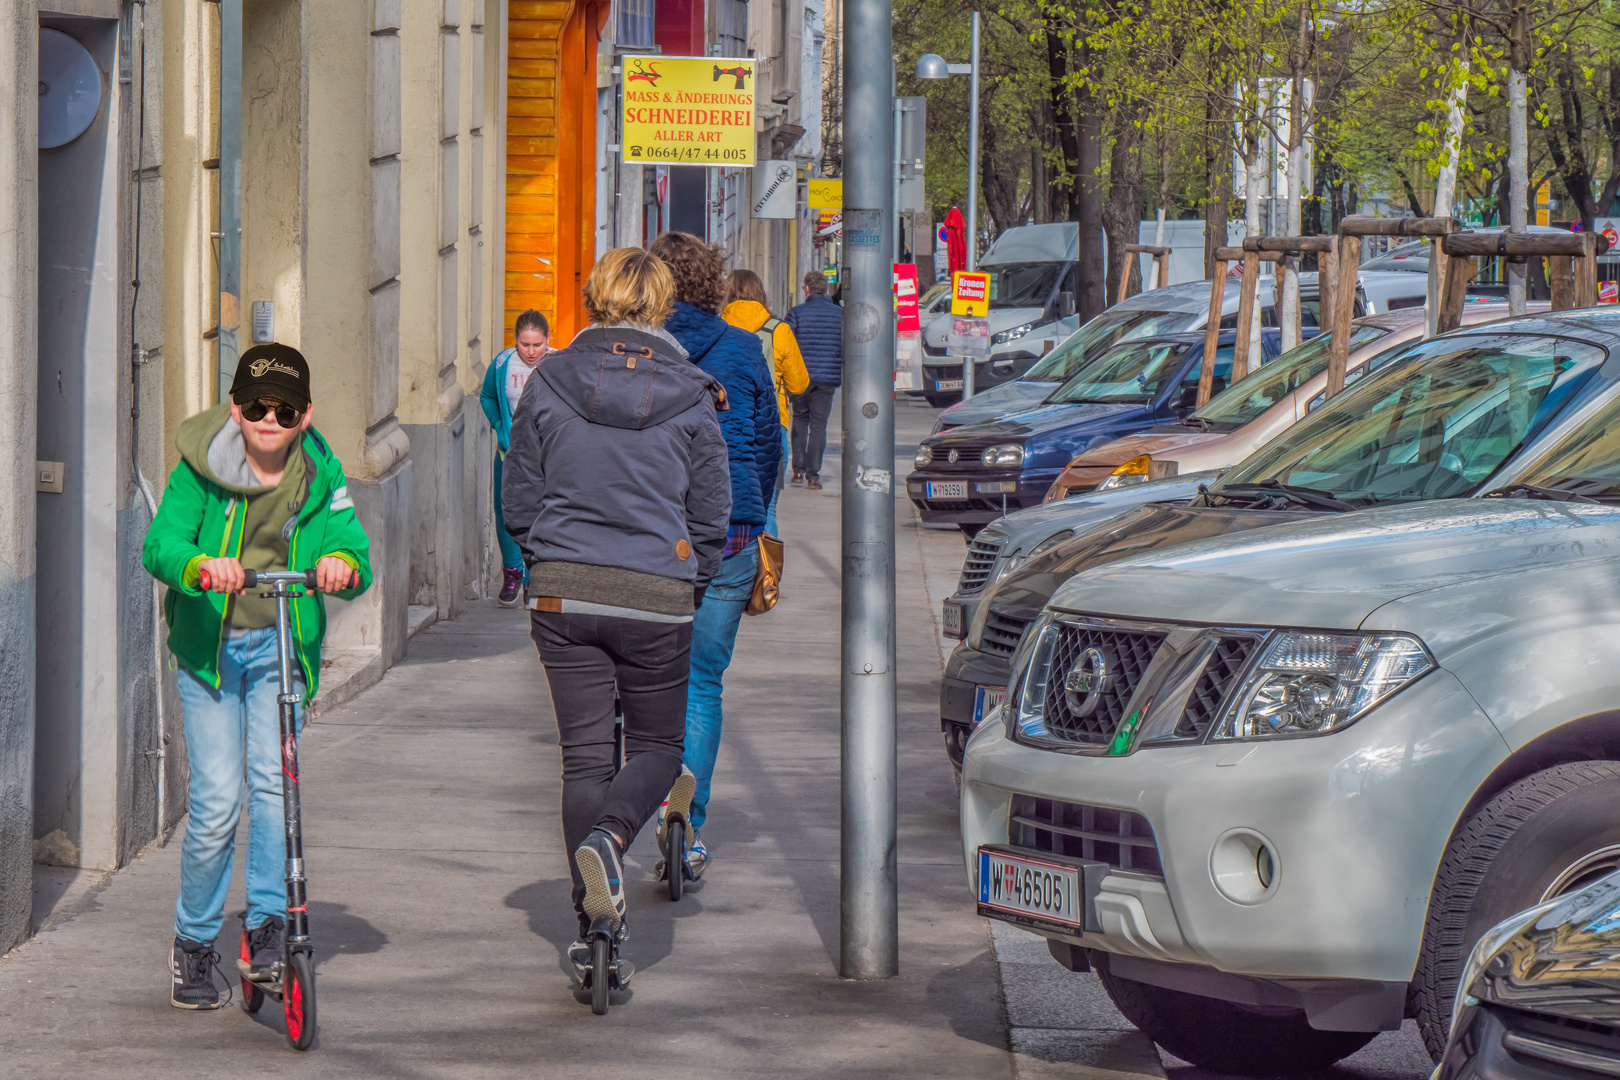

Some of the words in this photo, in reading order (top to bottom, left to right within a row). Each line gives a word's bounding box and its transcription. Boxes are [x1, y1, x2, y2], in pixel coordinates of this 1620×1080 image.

[626, 91, 660, 102] MASS
[663, 92, 672, 103] &
[675, 90, 753, 105] ÄNDERUNGS
[626, 107, 751, 126] SCHNEIDEREI
[654, 130, 694, 141] ALLER
[697, 131, 723, 142] ART
[647, 146, 701, 161] 0664/47
[704, 148, 720, 159] 44
[723, 149, 746, 159] 005
[958, 277, 985, 289] Kronen
[958, 287, 984, 299] Zeitung
[992, 861, 1004, 900] W
